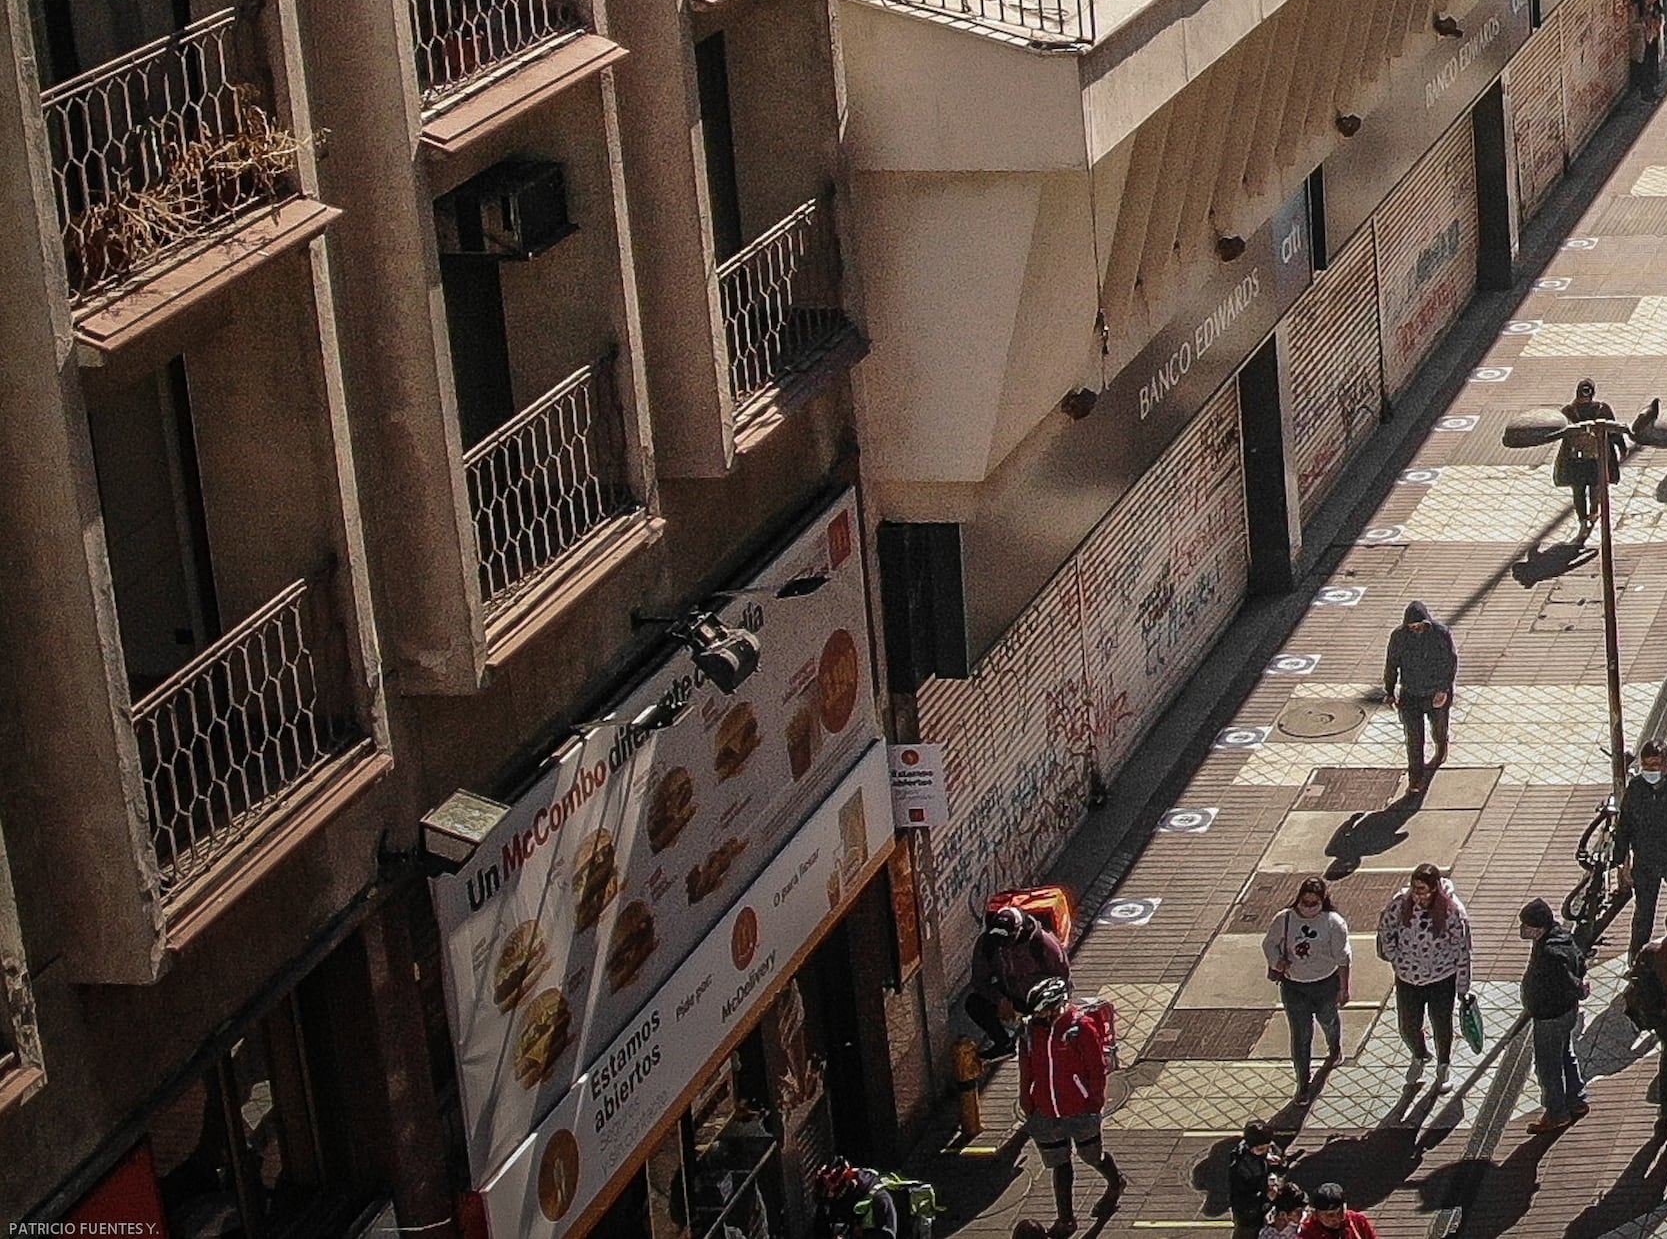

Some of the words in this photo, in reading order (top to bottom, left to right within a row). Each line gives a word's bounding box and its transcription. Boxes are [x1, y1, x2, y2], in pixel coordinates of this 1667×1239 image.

[1425, 56, 1458, 109] BANCO
[1459, 14, 1500, 72] EDWARDS
[1281, 224, 1301, 264] citi
[1139, 341, 1191, 421] BANCO
[1195, 266, 1260, 360] EDWARDS
[465, 863, 500, 912] Un
[502, 758, 607, 881] McCombo
[720, 947, 777, 1025] McDelivery
[590, 1008, 661, 1102] Estamos
[594, 1043, 662, 1134] abiertos
